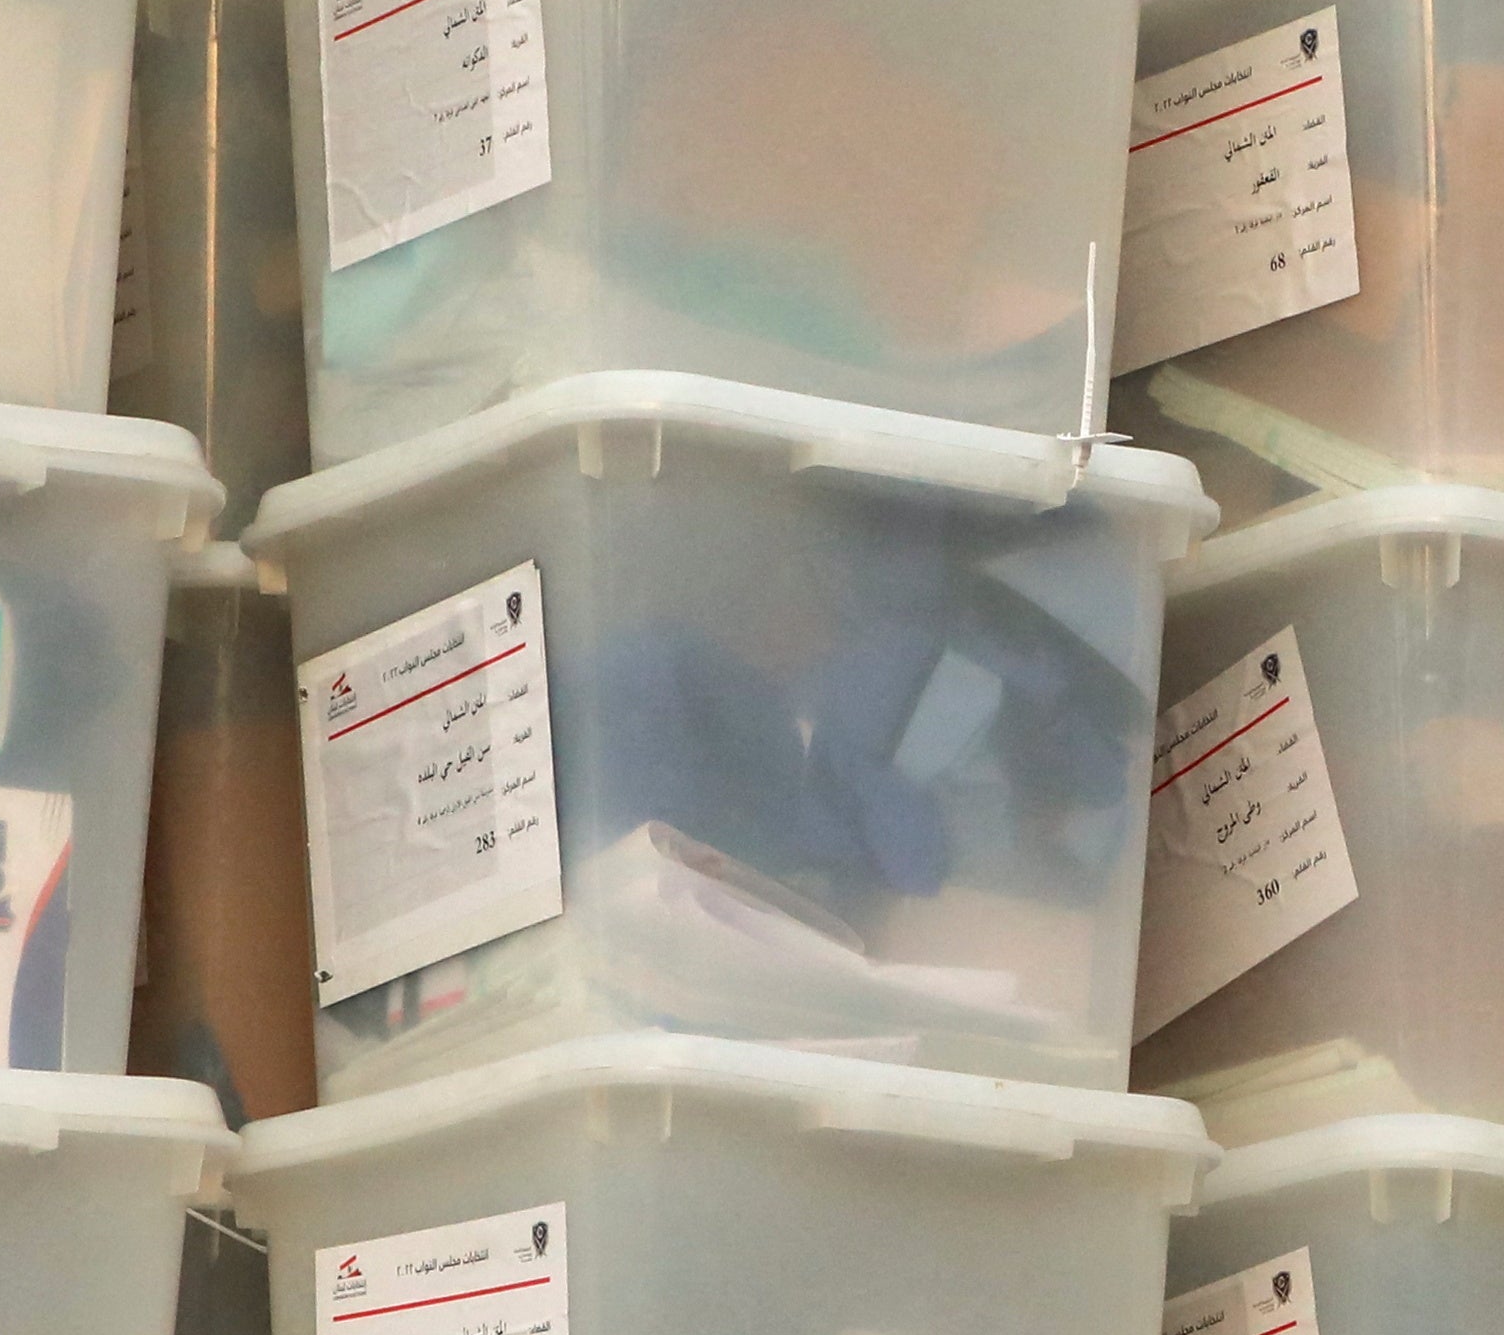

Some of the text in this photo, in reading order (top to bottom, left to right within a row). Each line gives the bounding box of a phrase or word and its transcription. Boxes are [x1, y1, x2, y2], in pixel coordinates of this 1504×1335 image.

[479, 135, 493, 157] 37
[1270, 252, 1287, 272] 68
[475, 830, 497, 855] 283
[1257, 878, 1280, 906] 360
